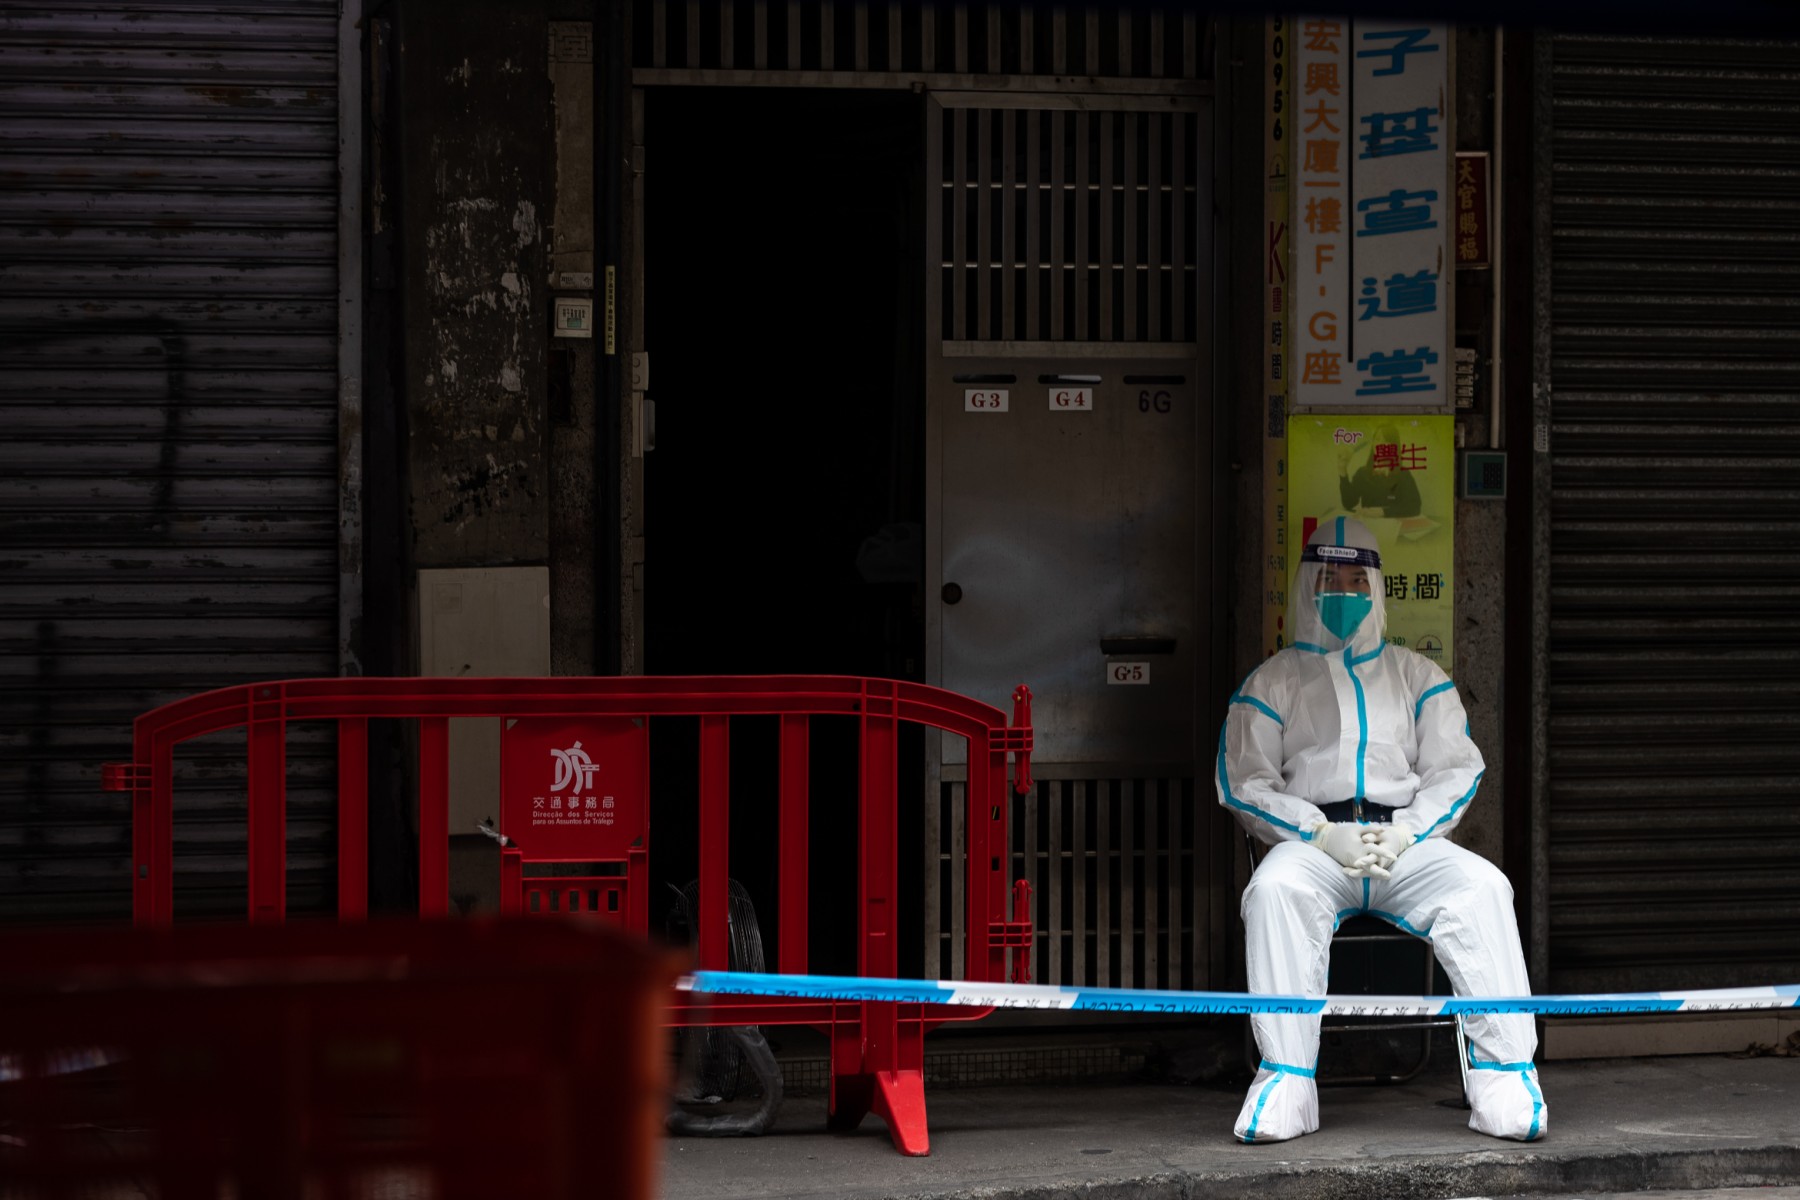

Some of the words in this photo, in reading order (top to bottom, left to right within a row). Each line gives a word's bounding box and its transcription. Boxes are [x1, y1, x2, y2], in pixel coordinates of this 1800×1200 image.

[1457, 159, 1479, 261] 天官賜福
[971, 393, 1001, 408] G3
[1055, 391, 1086, 407] G4
[1138, 390, 1172, 414] 6G
[1333, 428, 1364, 445] for
[1373, 443, 1428, 472] 學生
[1334, 549, 1356, 557] Shield
[1384, 574, 1439, 599] 時間
[533, 796, 615, 809] 交通事務局
[533, 811, 562, 819] Direcção
[567, 810, 580, 818] dos
[584, 810, 614, 819] Serviços
